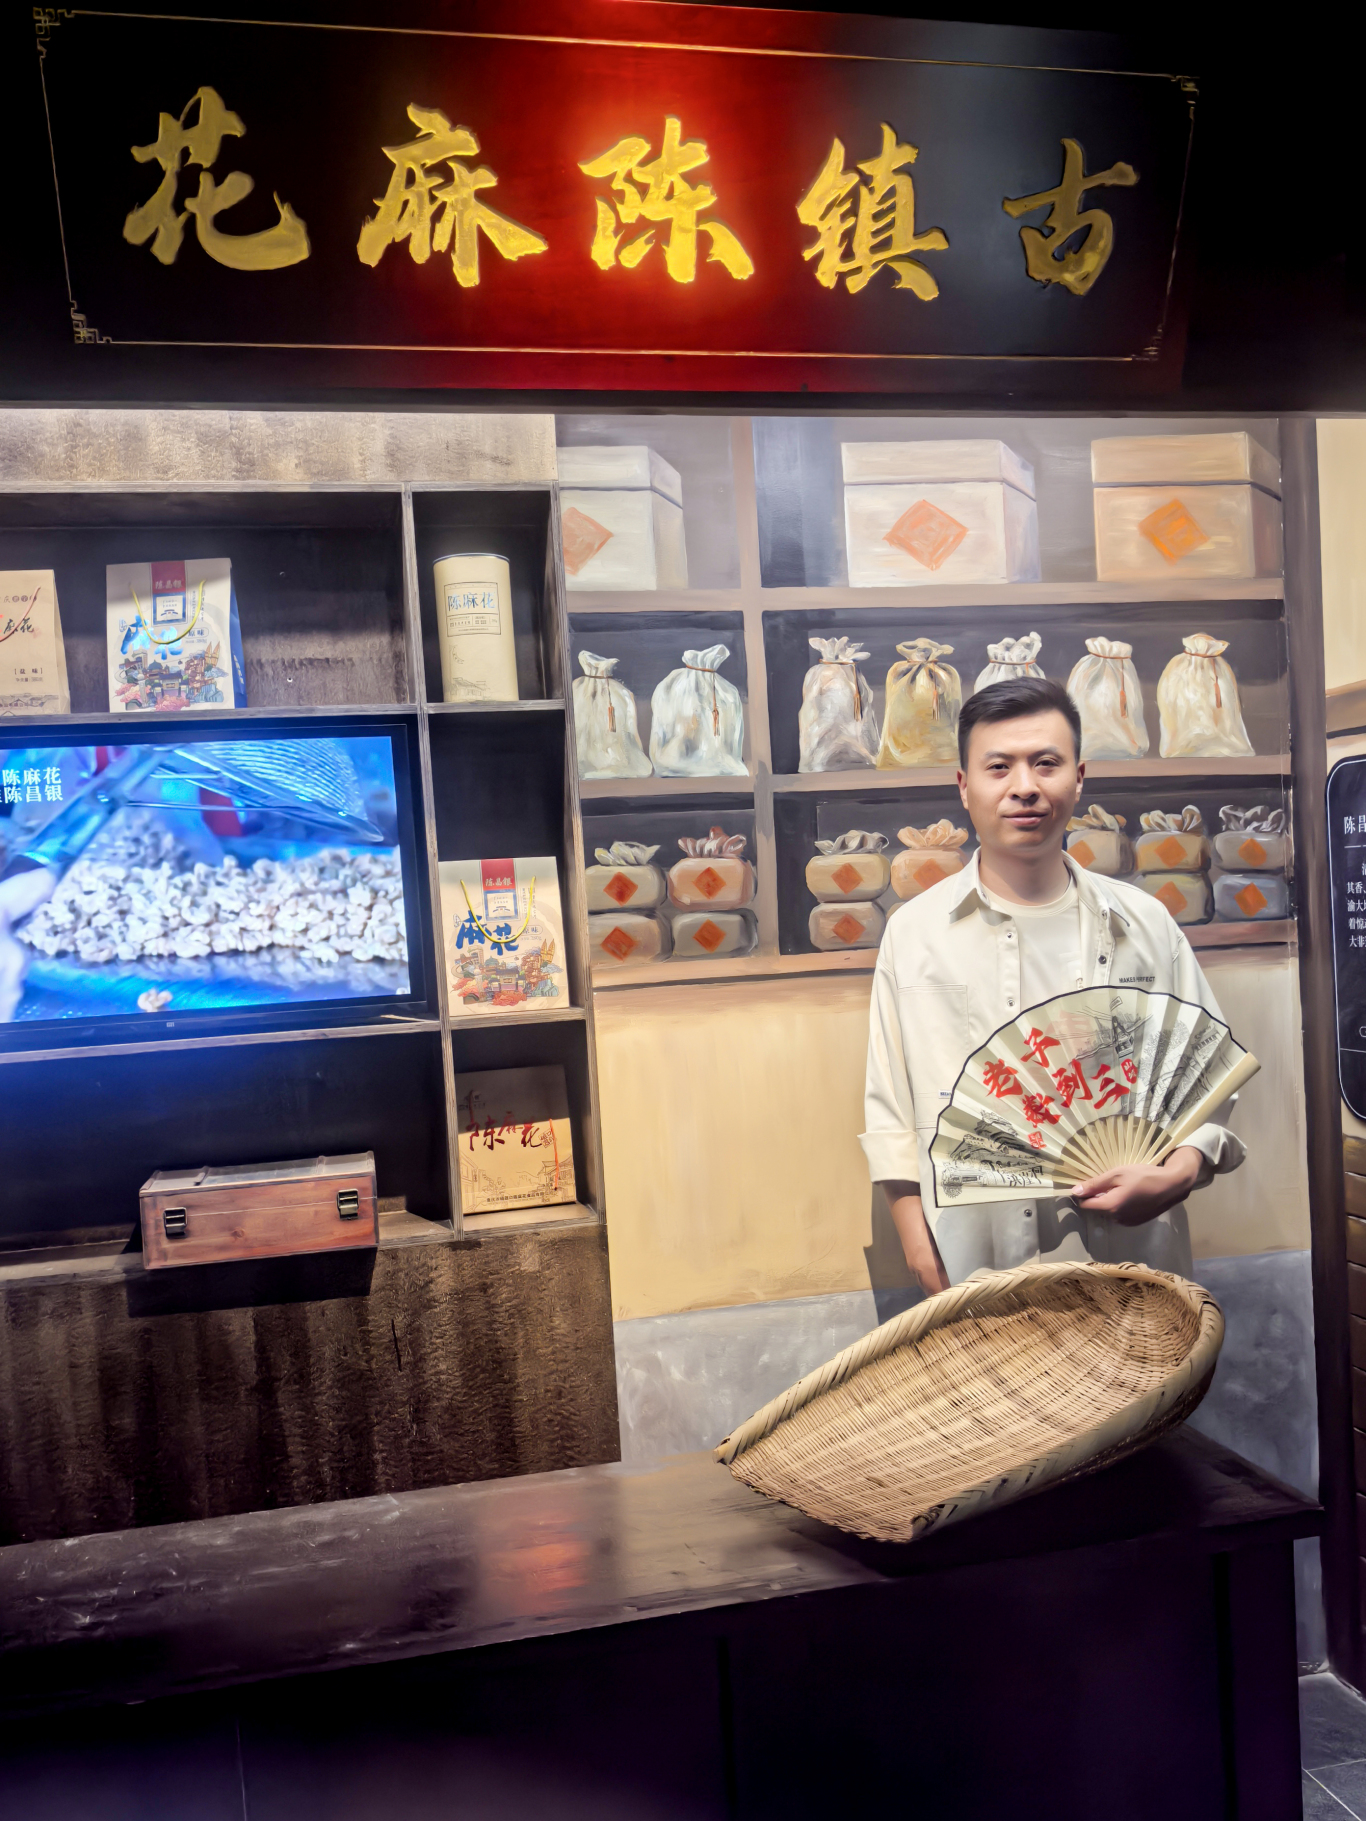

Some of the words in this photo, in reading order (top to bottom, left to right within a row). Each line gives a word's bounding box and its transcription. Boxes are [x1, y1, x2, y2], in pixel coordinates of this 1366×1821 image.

[2, 767, 62, 786] 陈麻花
[0, 785, 63, 804] 陈昌银
[485, 877, 513, 887] 陈昌银
[1349, 935, 1366, 948] 大非
